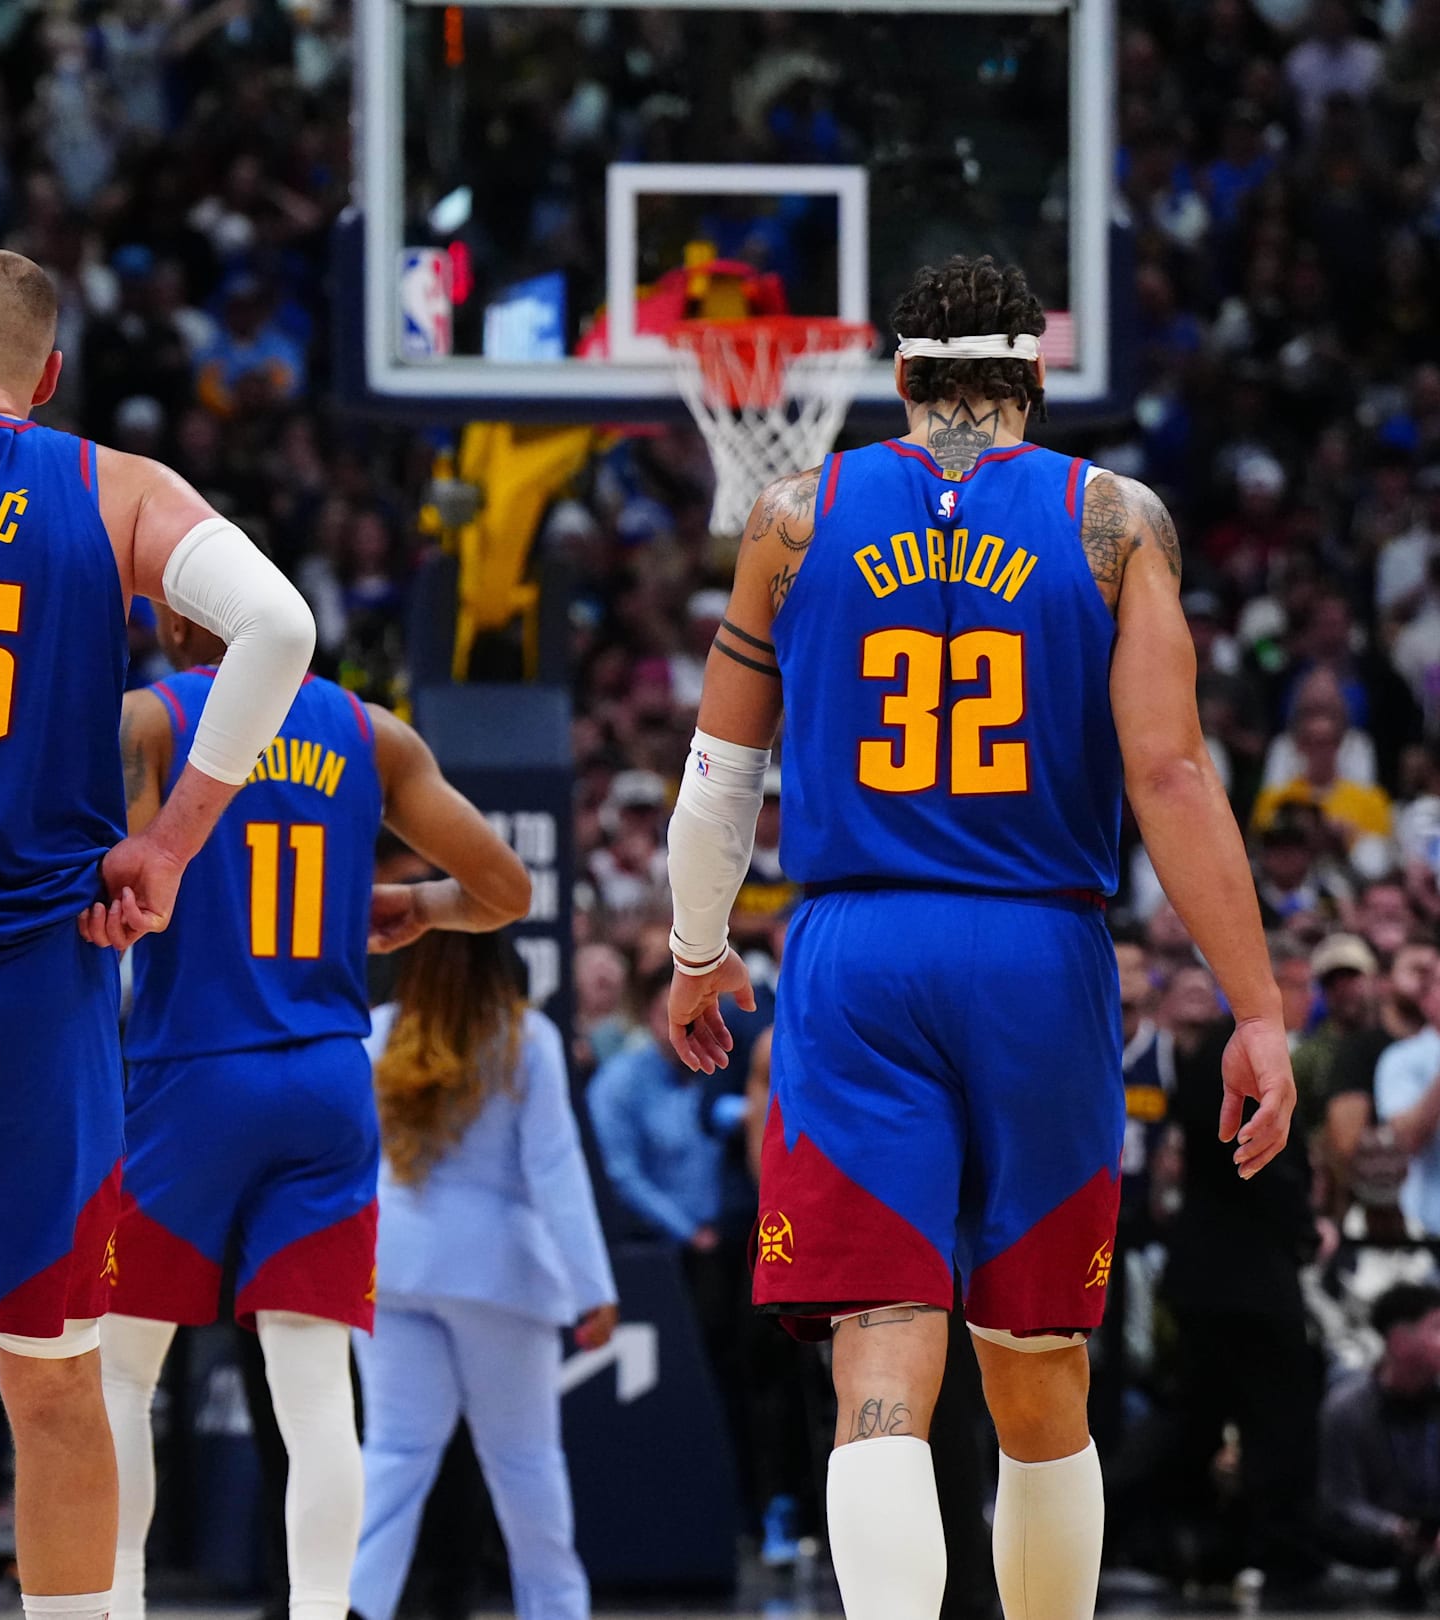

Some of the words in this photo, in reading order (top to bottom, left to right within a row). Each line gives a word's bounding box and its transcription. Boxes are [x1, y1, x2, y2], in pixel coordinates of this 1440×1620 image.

[853, 527, 1039, 604] GORDON
[857, 627, 1030, 796] 32
[246, 736, 347, 797] OWN
[245, 822, 326, 960] 11
